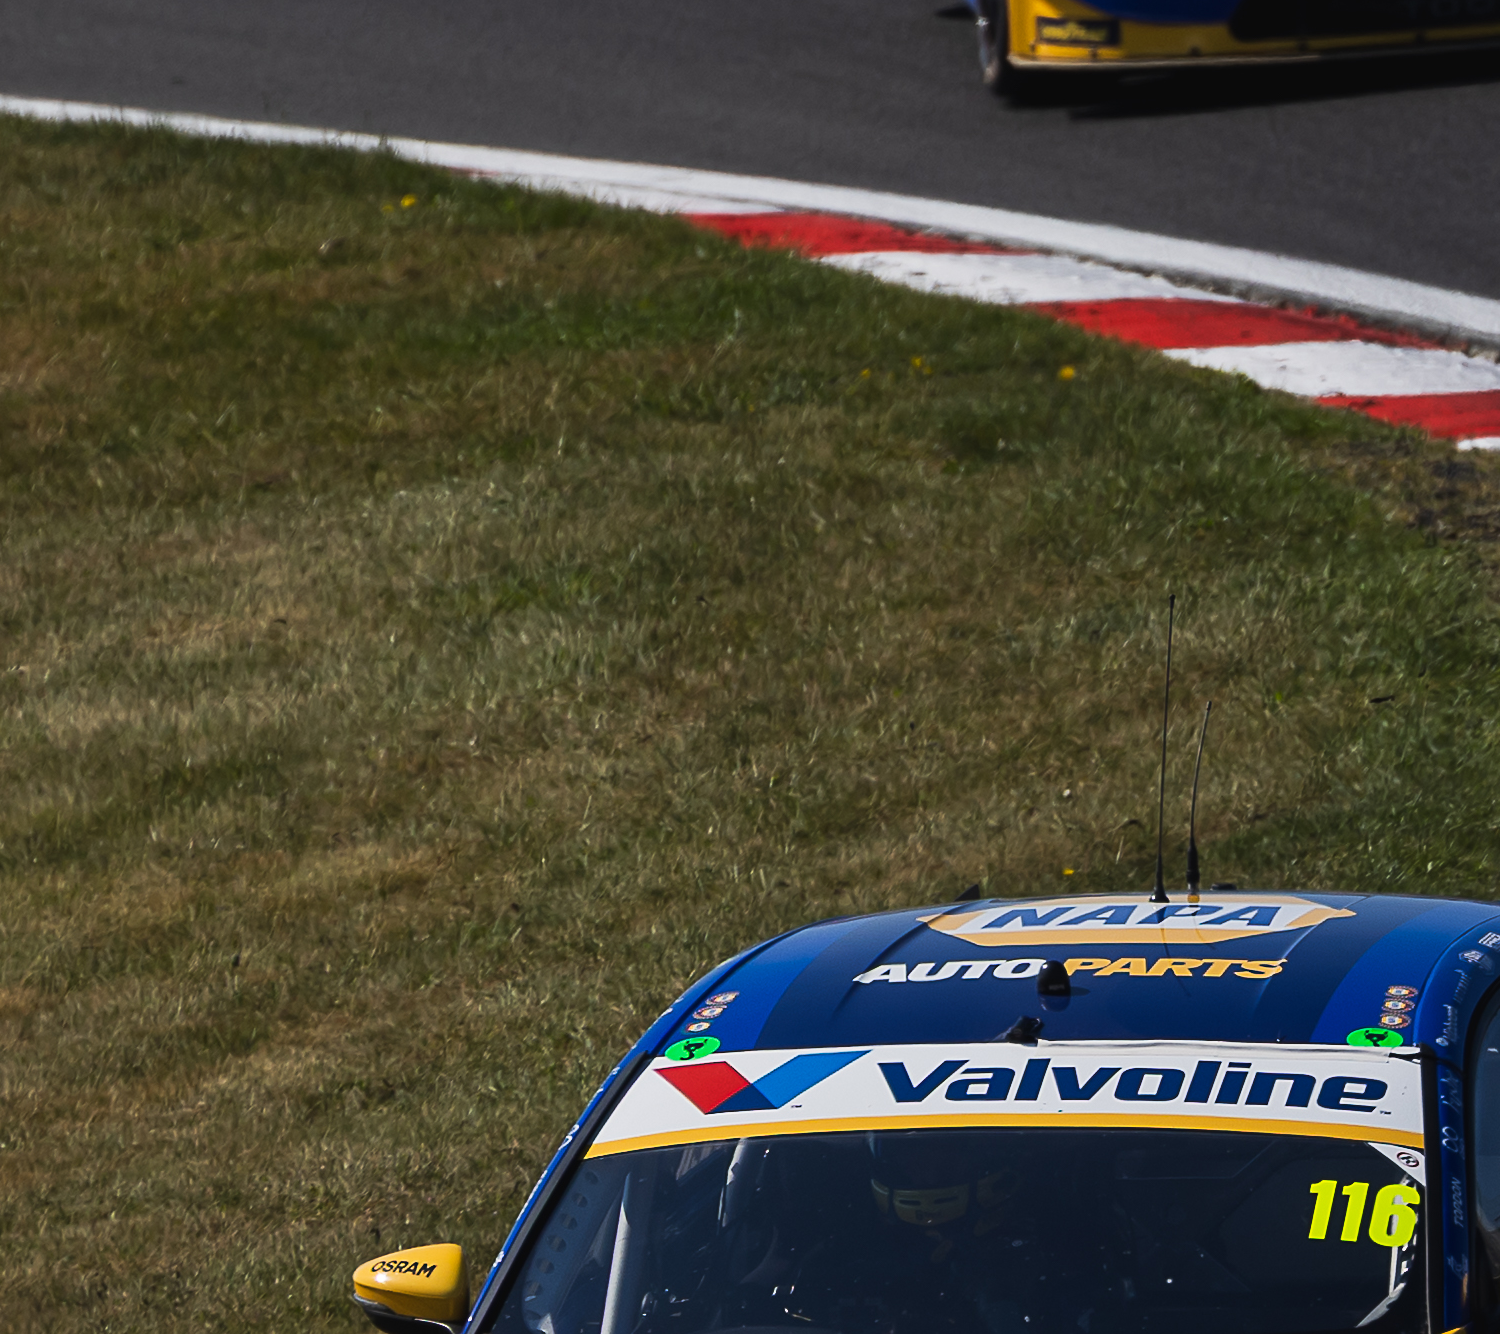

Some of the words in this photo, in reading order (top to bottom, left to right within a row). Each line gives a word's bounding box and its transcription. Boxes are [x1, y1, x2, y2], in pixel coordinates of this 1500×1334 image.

[982, 905, 1286, 930] NAPA
[853, 958, 1048, 985] AUTO
[1062, 957, 1288, 980] PARTS
[877, 1057, 1390, 1113] Valvoline
[1308, 1179, 1421, 1248] 116
[371, 1260, 438, 1279] OSRAM
